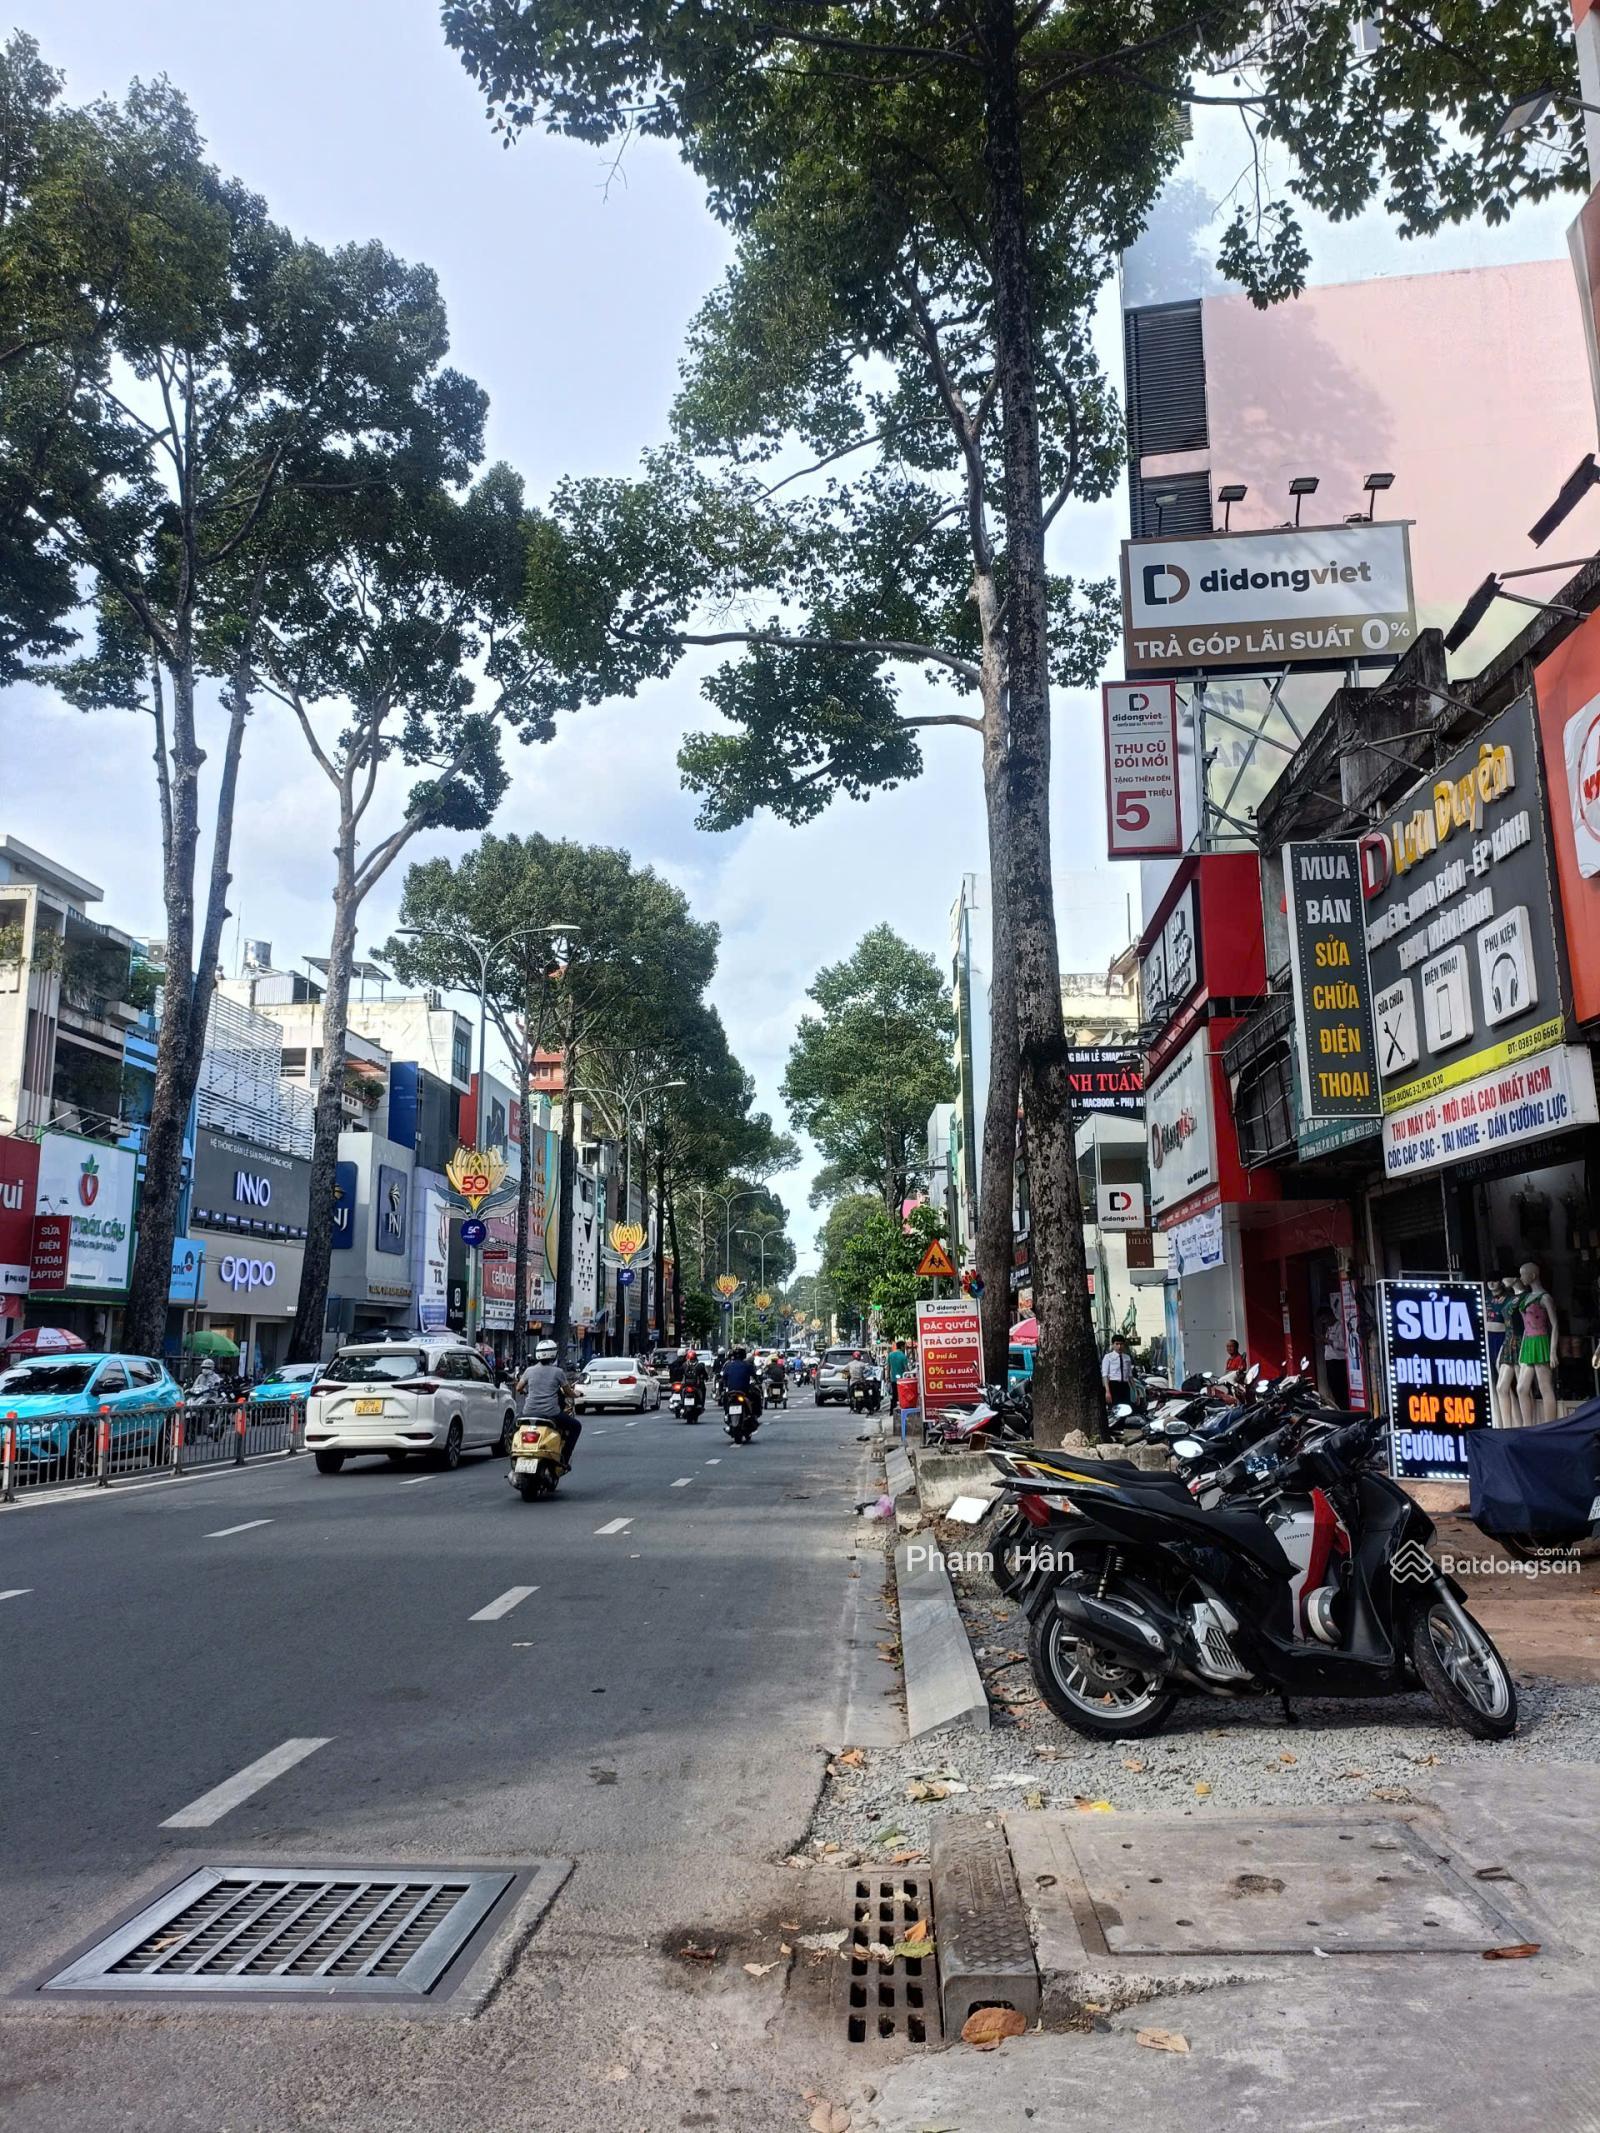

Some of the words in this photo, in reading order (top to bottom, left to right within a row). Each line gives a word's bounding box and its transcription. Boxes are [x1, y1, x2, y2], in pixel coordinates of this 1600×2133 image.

[1200, 561, 1371, 594] didongviet
[1134, 636, 1183, 659] TRẢ
[1188, 633, 1240, 655] GÓP
[1245, 629, 1285, 653] LÃI
[1290, 623, 1353, 649] SUẤT
[1361, 618, 1410, 650] 0%
[1112, 712, 1162, 722] didongviet
[1115, 743, 1143, 755] THU
[1147, 740, 1166, 753] CŨ
[1142, 754, 1168, 767] MỚI
[1148, 788, 1172, 797] TRIỆU
[1433, 743, 1516, 842] Duyên
[1116, 790, 1150, 831] 5
[1301, 856, 1351, 880] MUA
[1436, 860, 1467, 903] BÁN
[1472, 840, 1492, 878] ÉP
[1492, 810, 1531, 863] KÍNH
[1306, 898, 1352, 924] BÁN
[1315, 934, 1351, 967] SỬA
[1484, 933, 1499, 954] PHỤ
[1500, 921, 1517, 946] KIỆN
[1425, 966, 1439, 987] ĐIỆN
[1440, 956, 1458, 979] THOẠI
[1313, 980, 1360, 1010] CHỮA
[1076, 1051, 1089, 1062] BÁN
[1091, 1049, 1099, 1061] LẺ
[1320, 1023, 1361, 1059] ĐIỆN
[1518, 1037, 1533, 1051] 0383
[1096, 1066, 1143, 1091] TUẤN
[1318, 1072, 1369, 1102] THOẠI
[1120, 1097, 1134, 1108] PHỤ
[1392, 1122, 1407, 1142] THU
[1407, 1116, 1425, 1137] MÁY
[1425, 1105, 1437, 1131] CŨ
[1442, 1099, 1460, 1125] MỚI
[1461, 1091, 1478, 1117] GIÁ
[1478, 1088, 1497, 1112] CAO
[1498, 1072, 1525, 1105] NHẤT
[1526, 1065, 1552, 1096] HCM
[1402, 1141, 1418, 1166] CÁP
[1419, 1138, 1435, 1163] SẠC
[1442, 1132, 1455, 1153] TAI
[1456, 1122, 1480, 1149] NGHE
[1487, 1111, 1507, 1140] DÁN
[1509, 1101, 1544, 1134] CƯỜNG
[1546, 1092, 1568, 1125] LỰC
[462, 1175, 488, 1191] 50
[31, 1270, 63, 1279] LAPTOP
[923, 1322, 943, 1332] ĐẶC
[945, 1319, 977, 1330] QUYỀN
[1396, 1292, 1474, 1341] SỬA
[924, 1337, 942, 1346] TRẢ
[944, 1335, 964, 1345] GÓP
[928, 1367, 945, 1375] 0%
[1396, 1354, 1431, 1389] ĐIỆN
[1434, 1357, 1482, 1390] THOẠI
[1408, 1392, 1440, 1423] CÁP
[1443, 1396, 1476, 1428] SẠC
[1401, 1428, 1455, 1462] CƯỜNG
[1459, 1435, 1468, 1462] L
